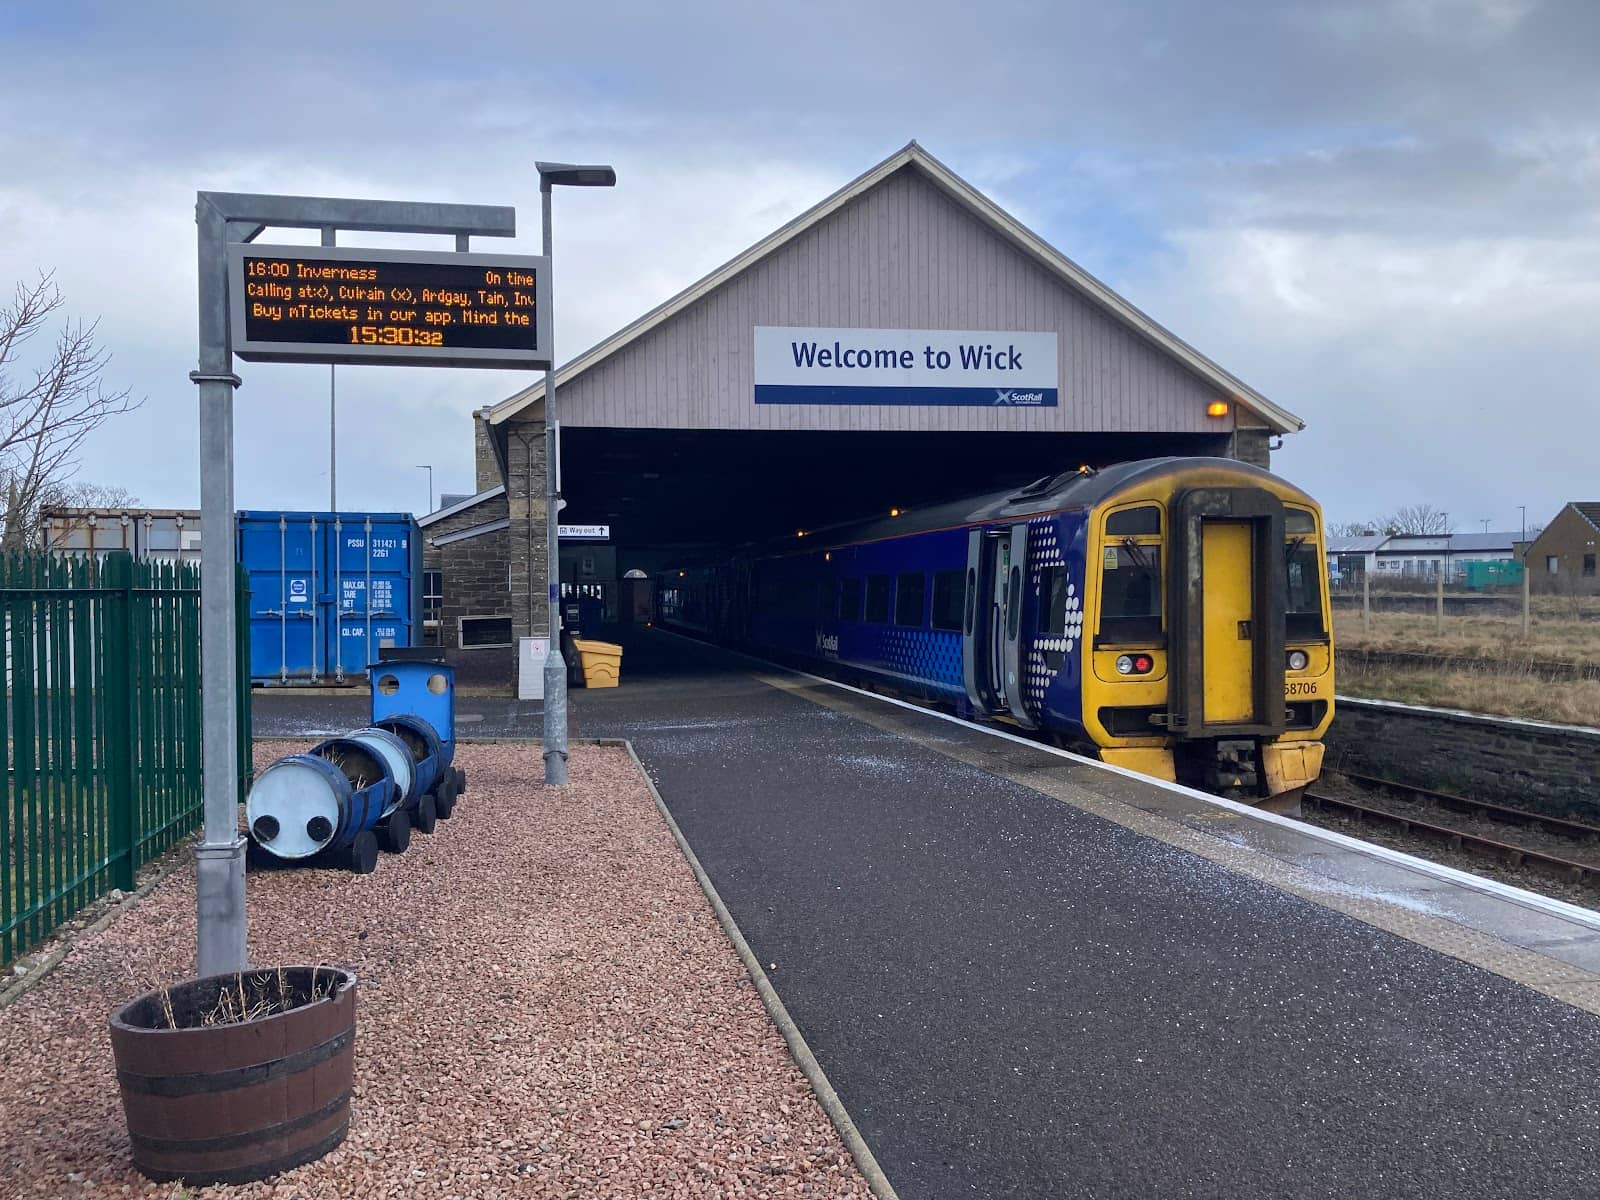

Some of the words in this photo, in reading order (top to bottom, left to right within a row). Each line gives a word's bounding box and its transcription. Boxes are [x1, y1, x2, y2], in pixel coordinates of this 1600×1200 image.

[248, 261, 289, 277] 16:00
[297, 264, 377, 280] Inverness
[486, 270, 501, 285] On
[506, 271, 534, 286] time
[247, 282, 292, 300] Calling
[339, 285, 385, 300] Culrain
[390, 287, 417, 305] (x),
[422, 288, 472, 307] Ardgay,
[478, 290, 509, 308] Tain,
[253, 303, 282, 321] Buy
[289, 304, 359, 319] mTickets
[367, 306, 383, 320] in
[390, 310, 416, 321] our
[425, 311, 456, 326] app.
[463, 309, 497, 324] Mind
[504, 311, 530, 325] the
[350, 325, 443, 346] 15:30:32
[792, 341, 914, 369] Welcome
[924, 345, 951, 370] to
[959, 344, 1023, 370] Wick
[1011, 392, 1043, 401] ScotRail
[570, 527, 583, 535] Way
[347, 539, 365, 548] PSSU
[343, 599, 354, 608] NET
